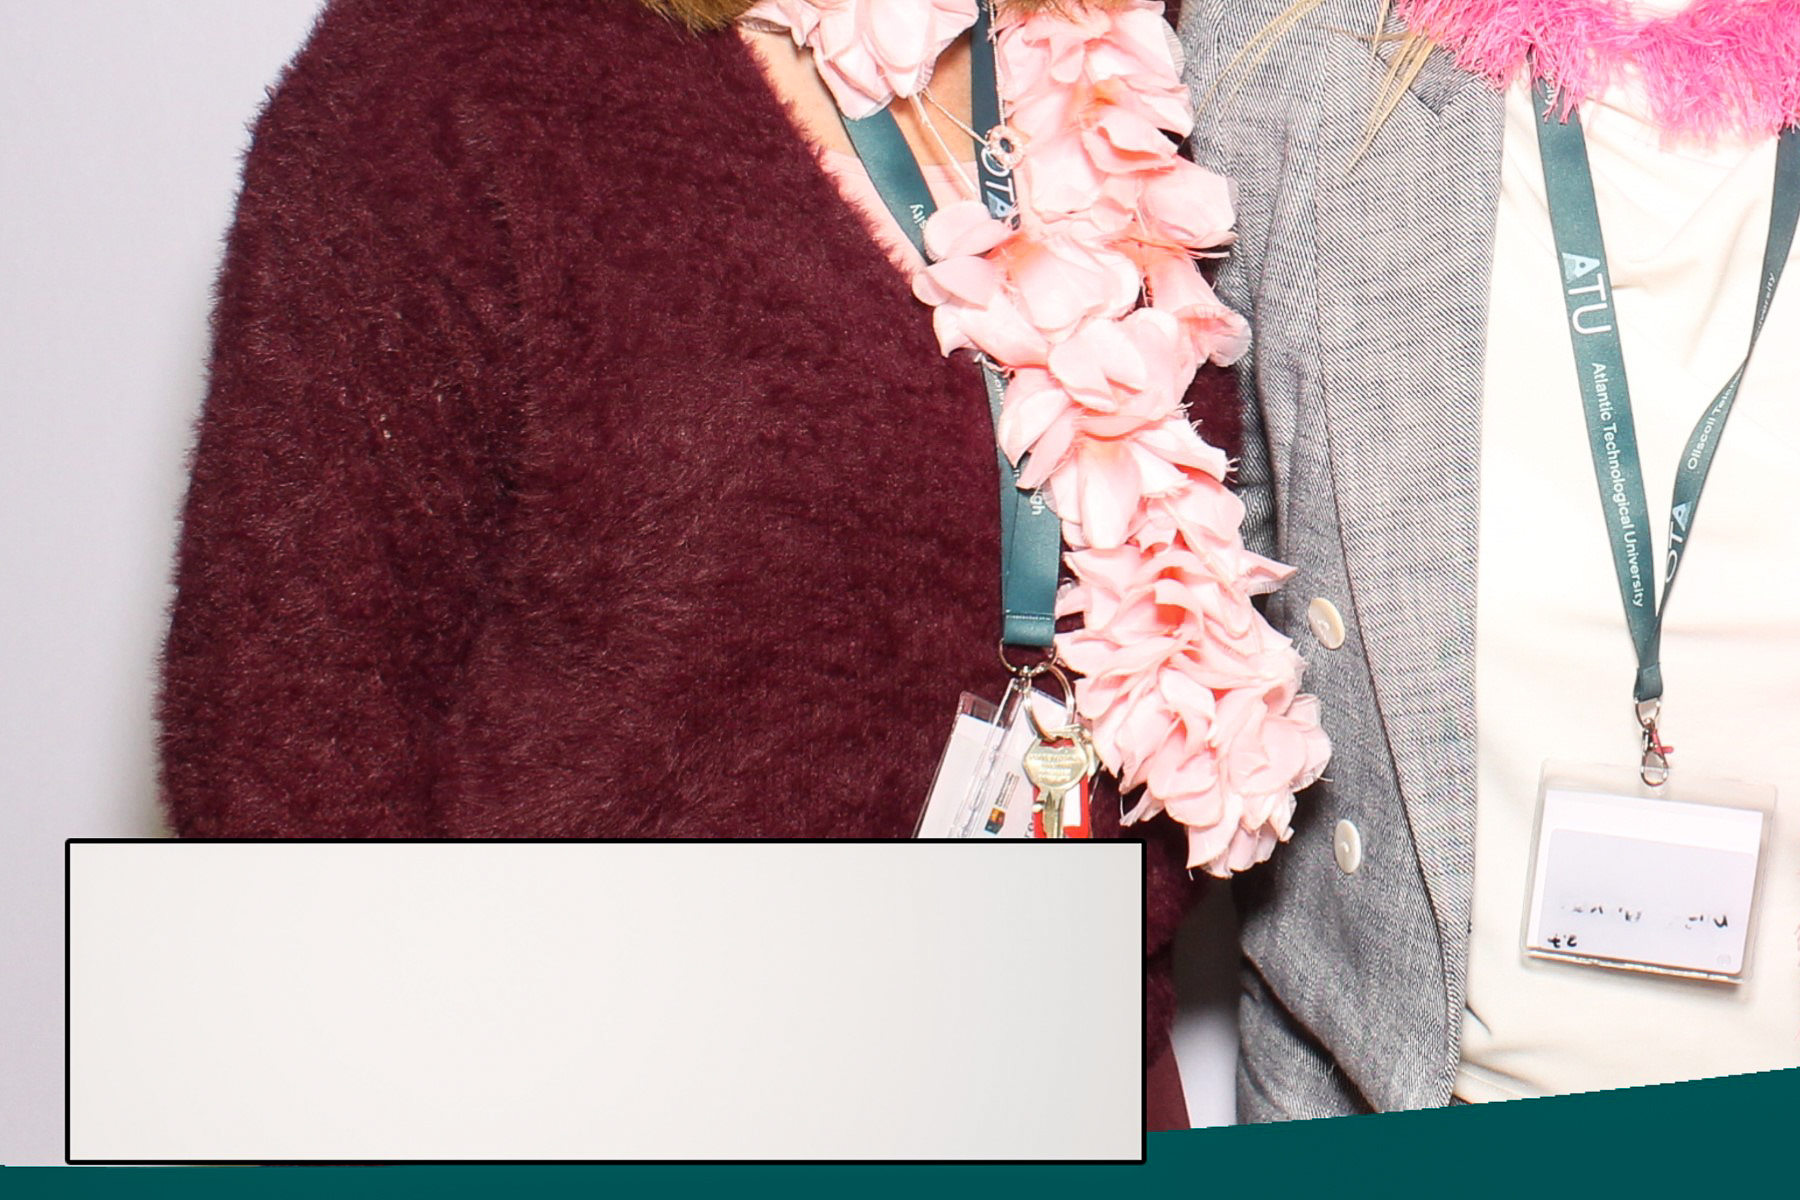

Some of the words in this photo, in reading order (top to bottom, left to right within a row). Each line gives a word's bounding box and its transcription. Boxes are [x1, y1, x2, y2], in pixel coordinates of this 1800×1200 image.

[1561, 251, 1612, 335] ATU
[1591, 362, 1613, 422] Atlantic
[1602, 421, 1634, 530] Technological
[1624, 530, 1644, 608] University
